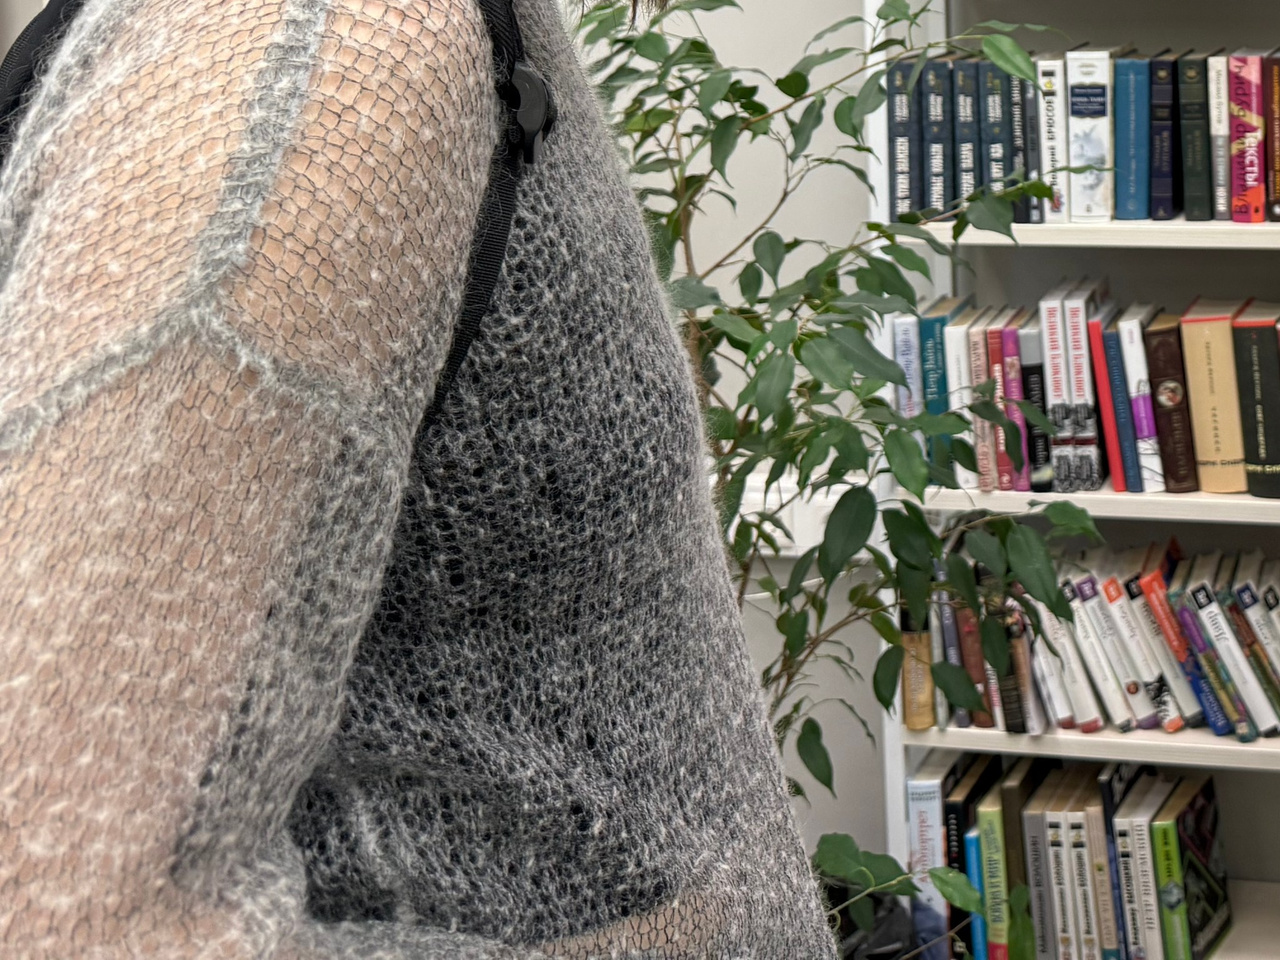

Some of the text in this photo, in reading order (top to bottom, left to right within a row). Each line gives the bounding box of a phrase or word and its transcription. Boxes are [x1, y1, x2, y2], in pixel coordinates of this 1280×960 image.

[1215, 101, 1224, 125] Бутов
[989, 143, 1003, 159] АДА
[1233, 64, 1249, 215] Владимир Бурич
[1216, 186, 1227, 211] КОЖИ
[1028, 835, 1044, 888] ВОЛОШИН
